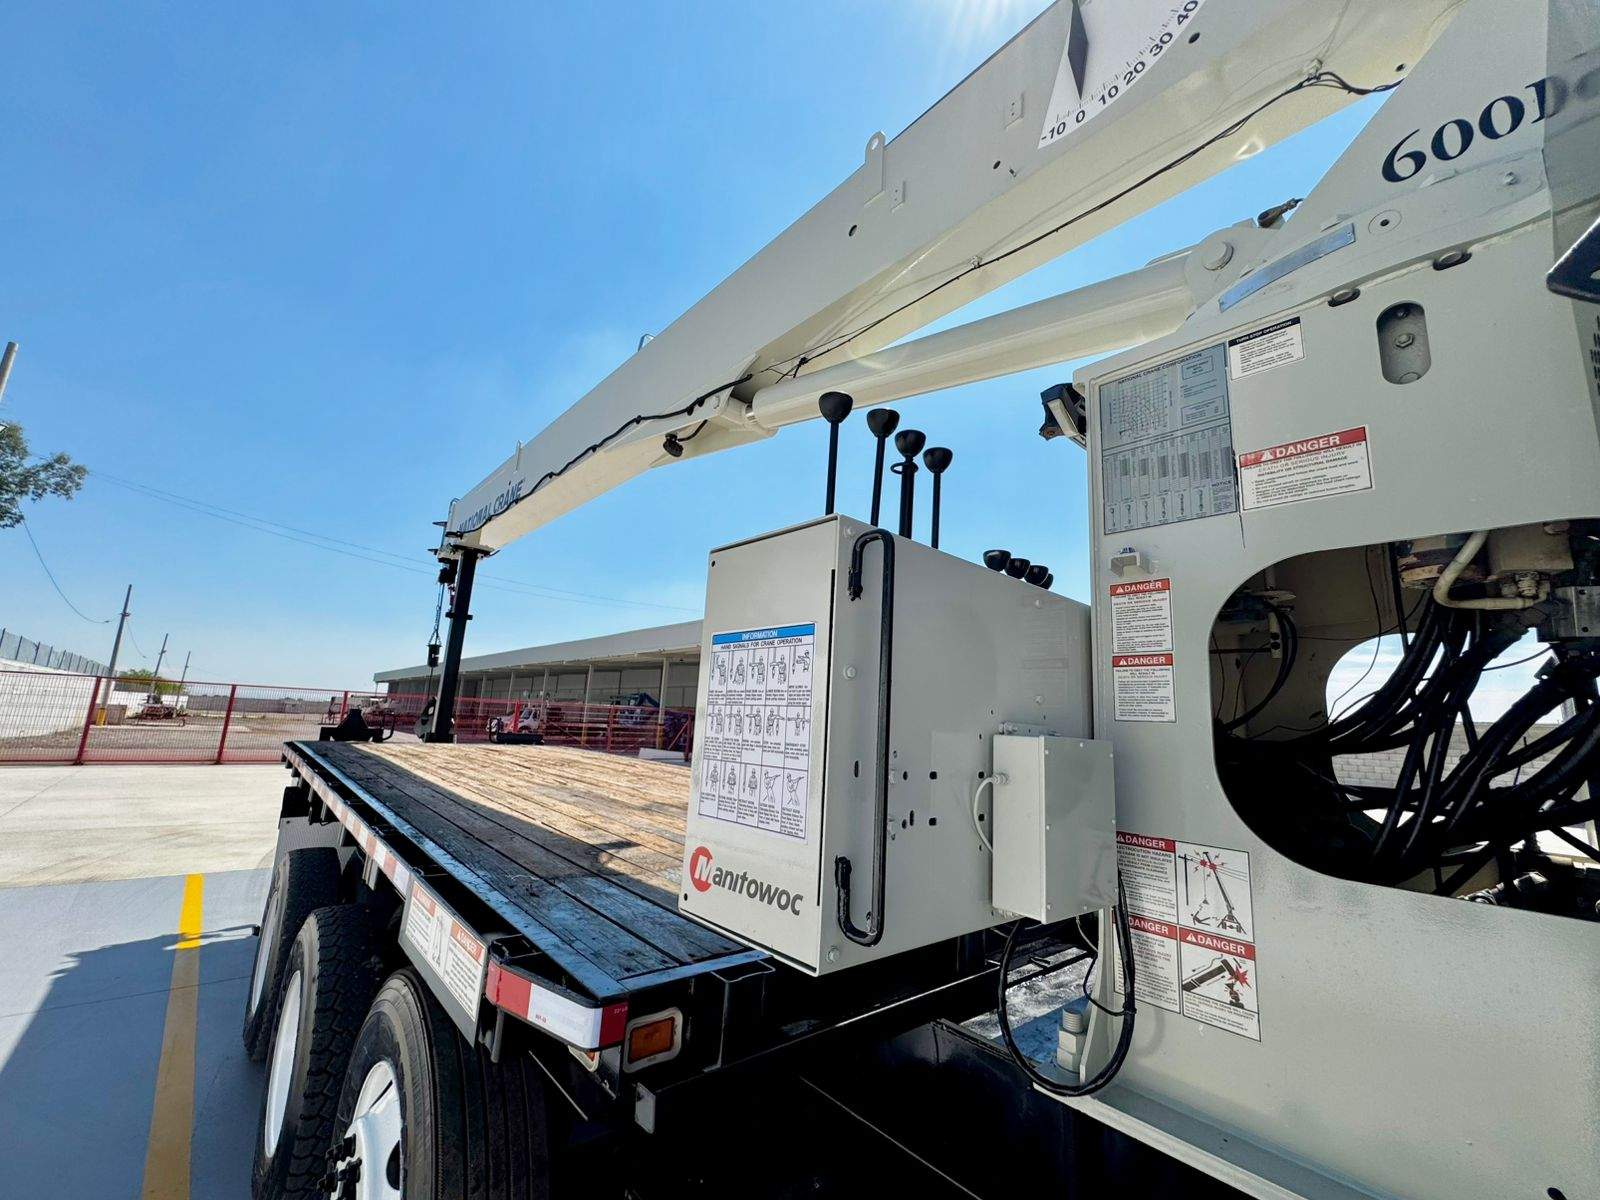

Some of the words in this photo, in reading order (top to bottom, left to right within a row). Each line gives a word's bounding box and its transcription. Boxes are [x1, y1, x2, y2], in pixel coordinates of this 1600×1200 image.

[1041, 122, 1066, 140] -10
[1075, 110, 1086, 123] 0
[1098, 85, 1119, 105] 10
[1123, 61, 1146, 85] 20
[1150, 32, 1173, 57] 30
[1176, 0, 1198, 26] 40
[1118, 372, 1141, 384] NATIONAL
[1143, 366, 1160, 376] CRANE
[1161, 351, 1202, 370] CORPORATION
[1275, 434, 1340, 457] DANGER
[1290, 455, 1319, 465] SERIOUS
[1320, 449, 1345, 459] INJURY
[1325, 455, 1347, 463] DAMAGE
[494, 479, 524, 514] CRANE
[1124, 581, 1161, 592] DANGER
[741, 629, 777, 640] INFORMATION
[760, 639, 775, 647] CRANE
[776, 637, 802, 646] OPERATION
[1127, 656, 1165, 664] DANGER
[1125, 835, 1165, 849] DANGER
[690, 846, 803, 916] Manitowoc
[1128, 915, 1168, 936] DANGER
[1196, 935, 1247, 957] DANGER
